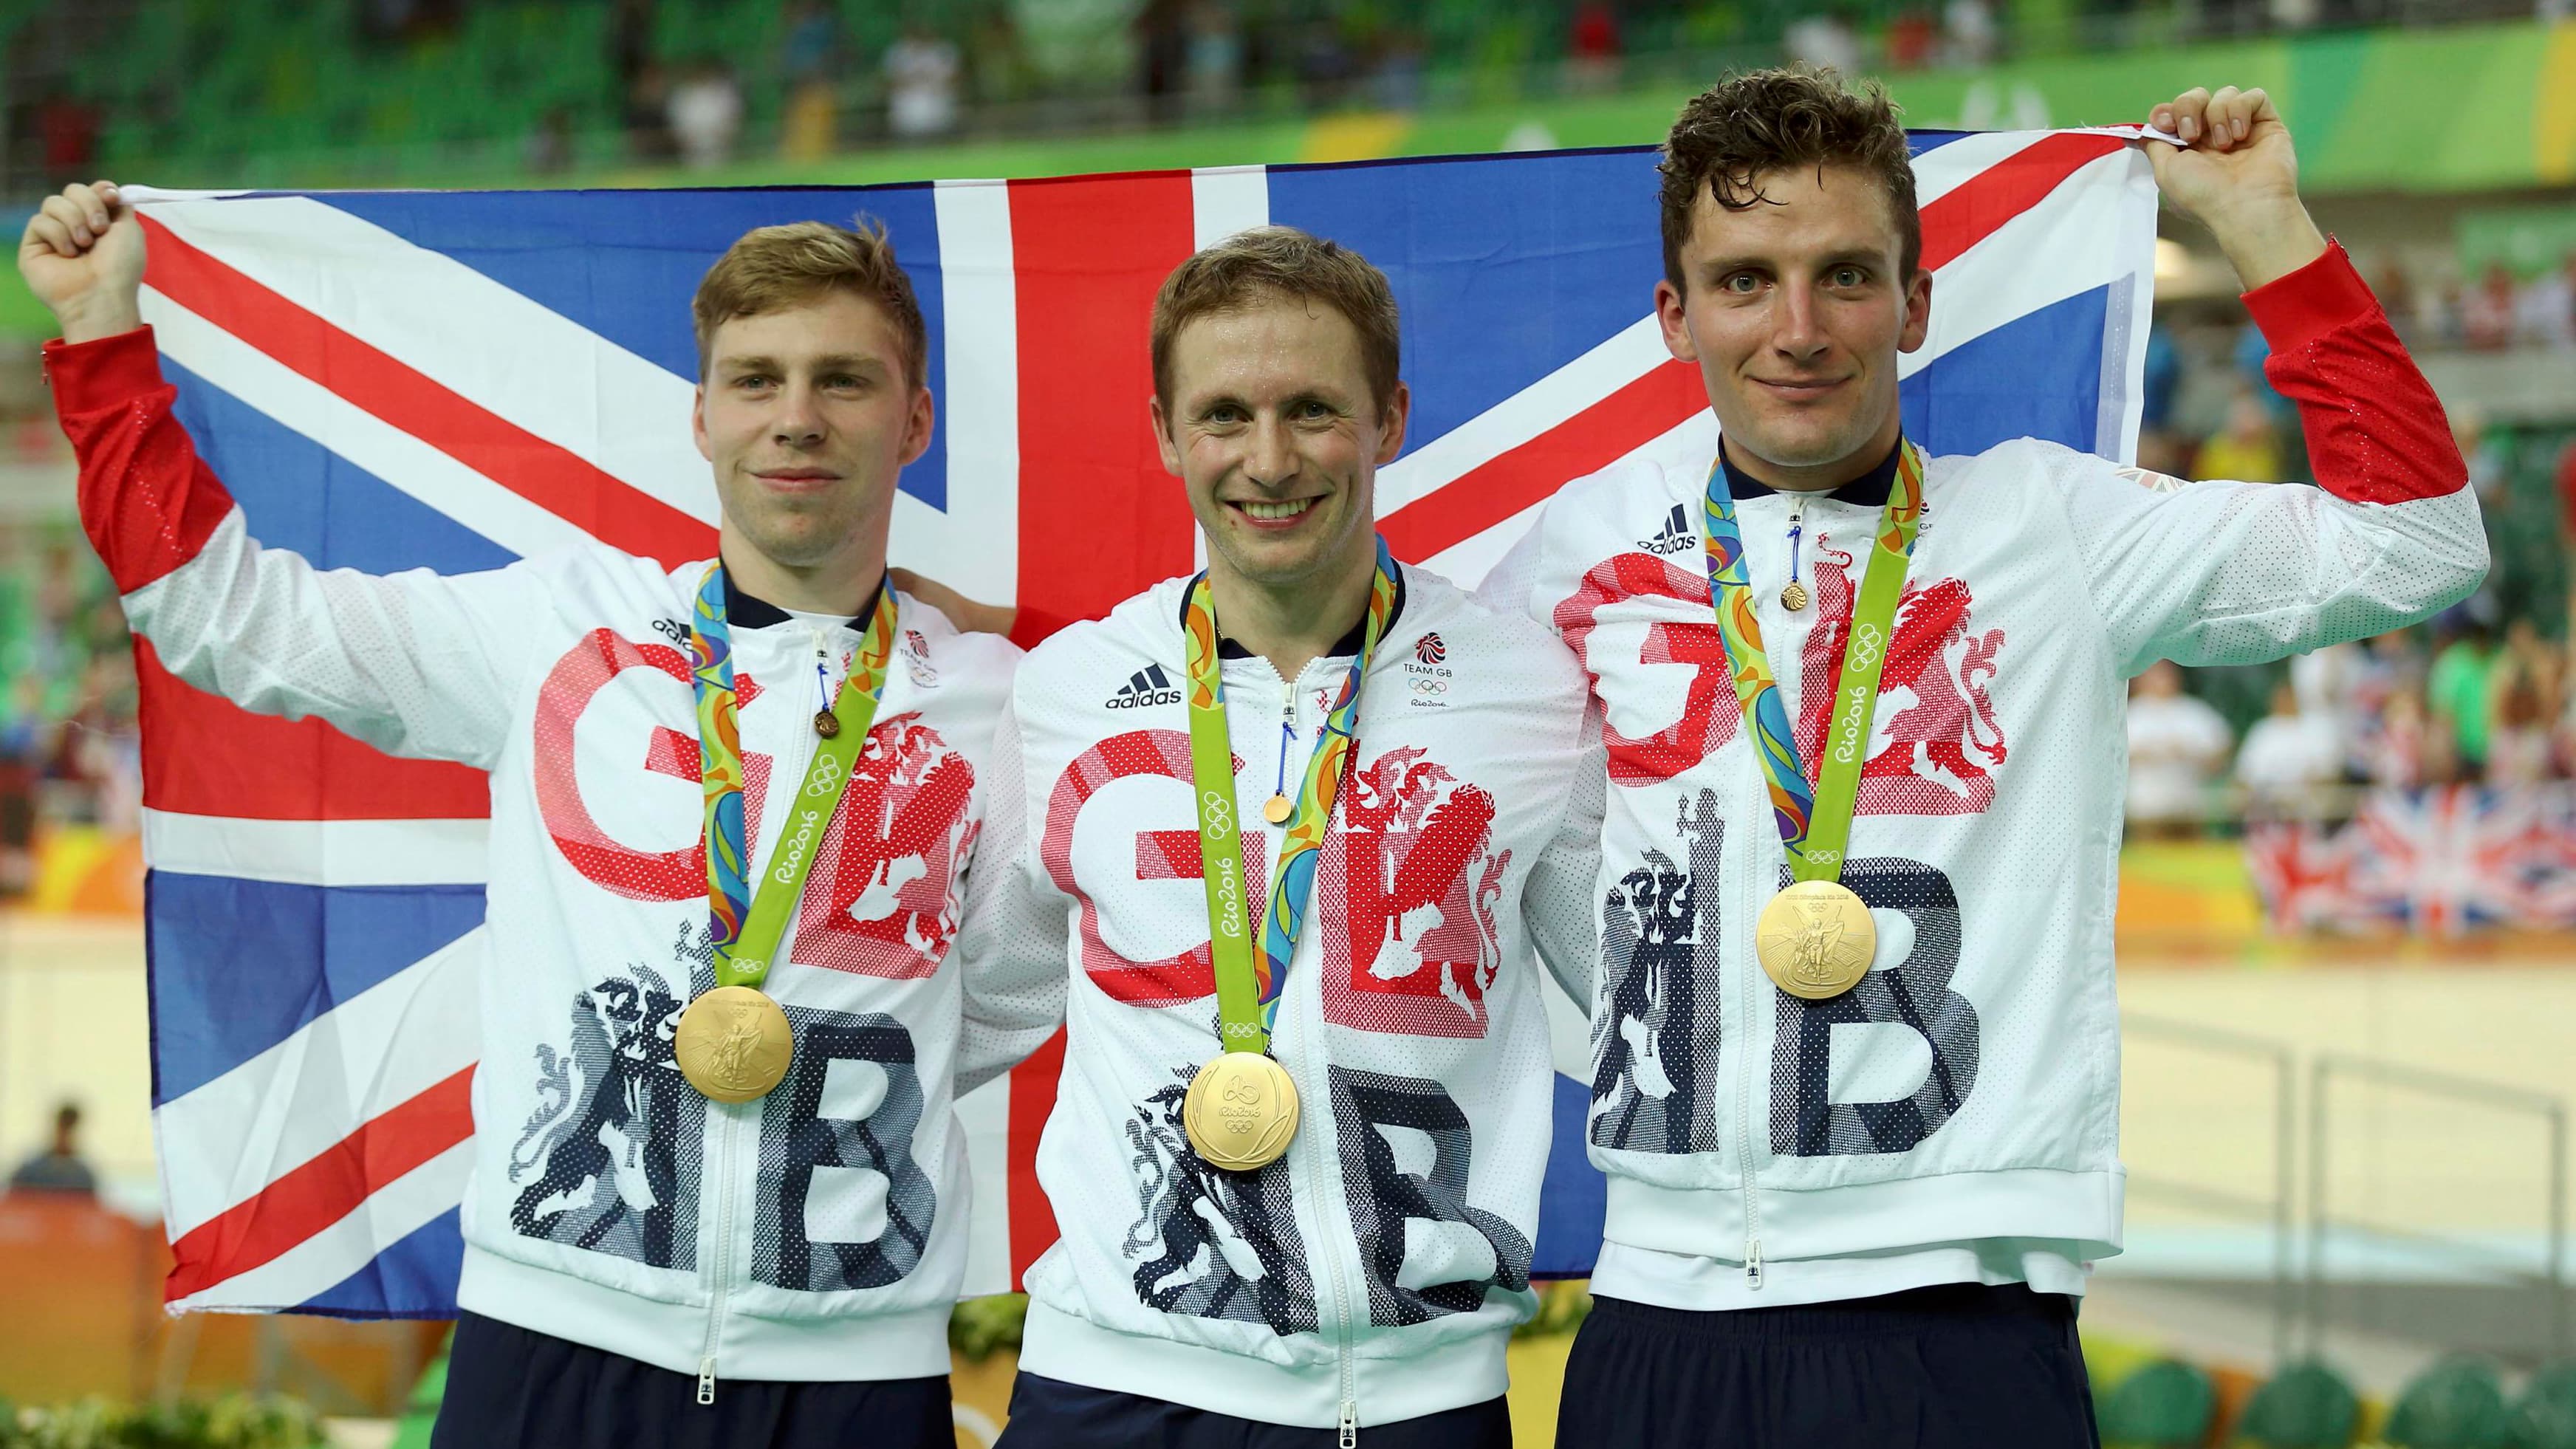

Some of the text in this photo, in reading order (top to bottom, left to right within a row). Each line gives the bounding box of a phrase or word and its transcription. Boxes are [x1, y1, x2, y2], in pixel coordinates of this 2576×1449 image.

[1637, 533, 1696, 555] adidas
[651, 620, 693, 652] adi
[1403, 663, 1452, 677] TEAM GB
[1106, 689, 1182, 709] adidas
[1411, 699, 1448, 707] Rio2016
[1835, 686, 1866, 763] Rio2016
[775, 810, 818, 883] Rio2016
[1214, 857, 1241, 938] Rio2016
[1219, 1106, 1261, 1117] Rio2016
